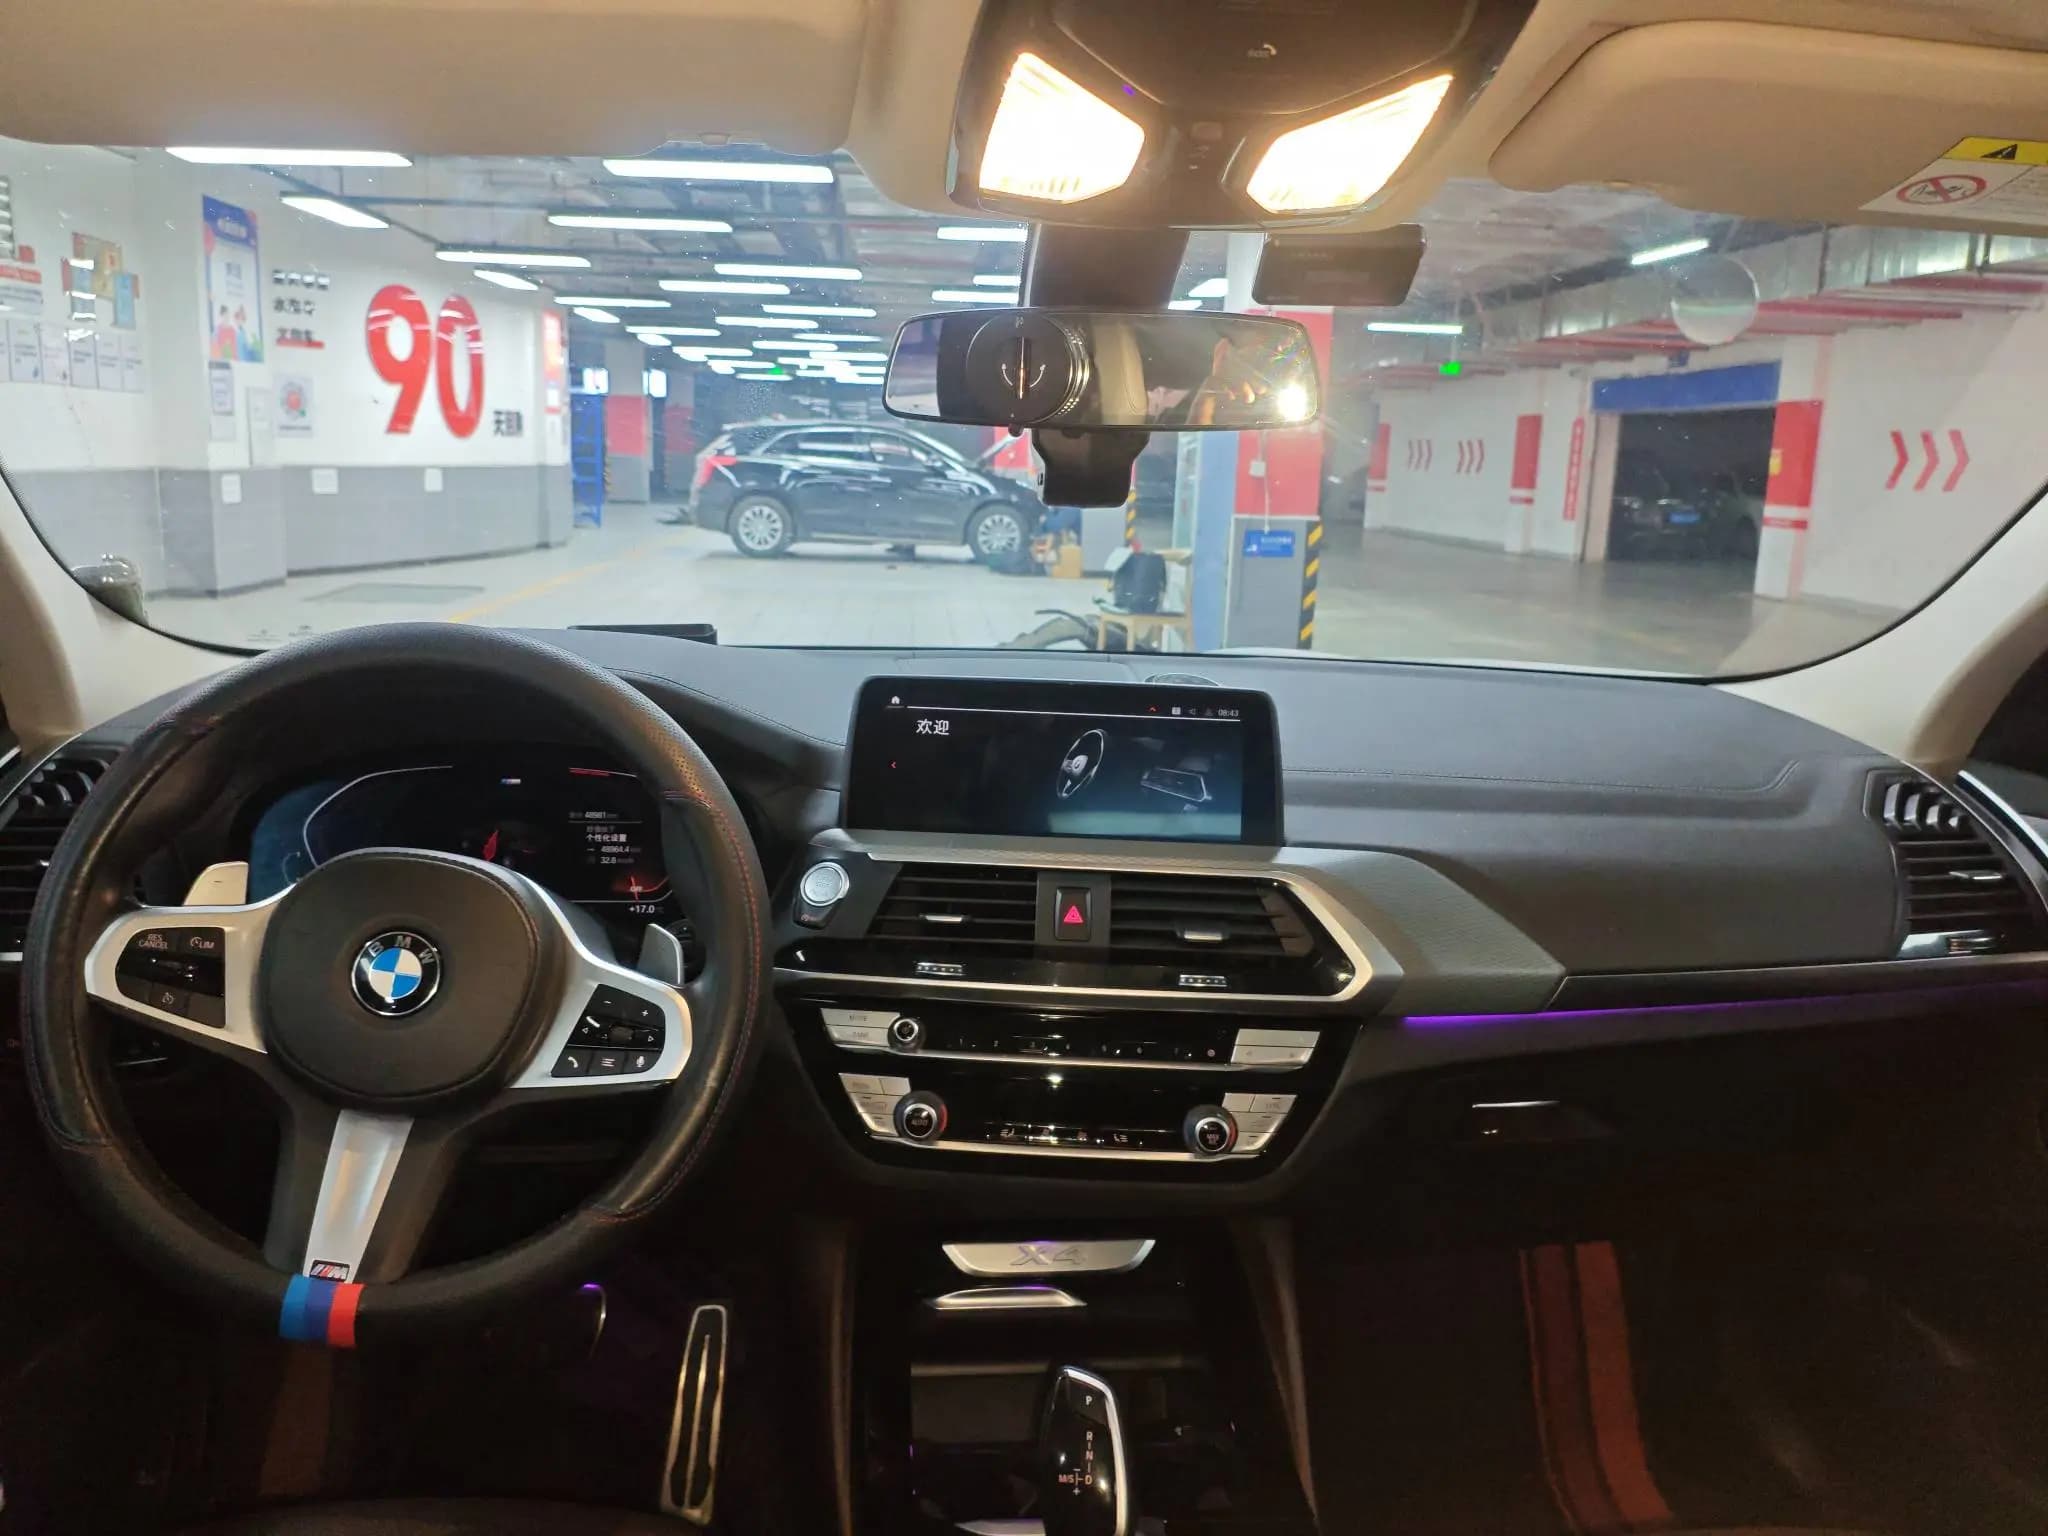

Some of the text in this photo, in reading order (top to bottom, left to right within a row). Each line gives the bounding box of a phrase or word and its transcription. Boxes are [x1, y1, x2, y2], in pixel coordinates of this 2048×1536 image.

[366, 284, 485, 439] 90
[915, 718, 949, 735] 欢迎
[367, 935, 436, 965] BMW
[1009, 1244, 1086, 1266] X4
[1085, 1395, 1093, 1406] P
[1086, 1431, 1093, 1441] R
